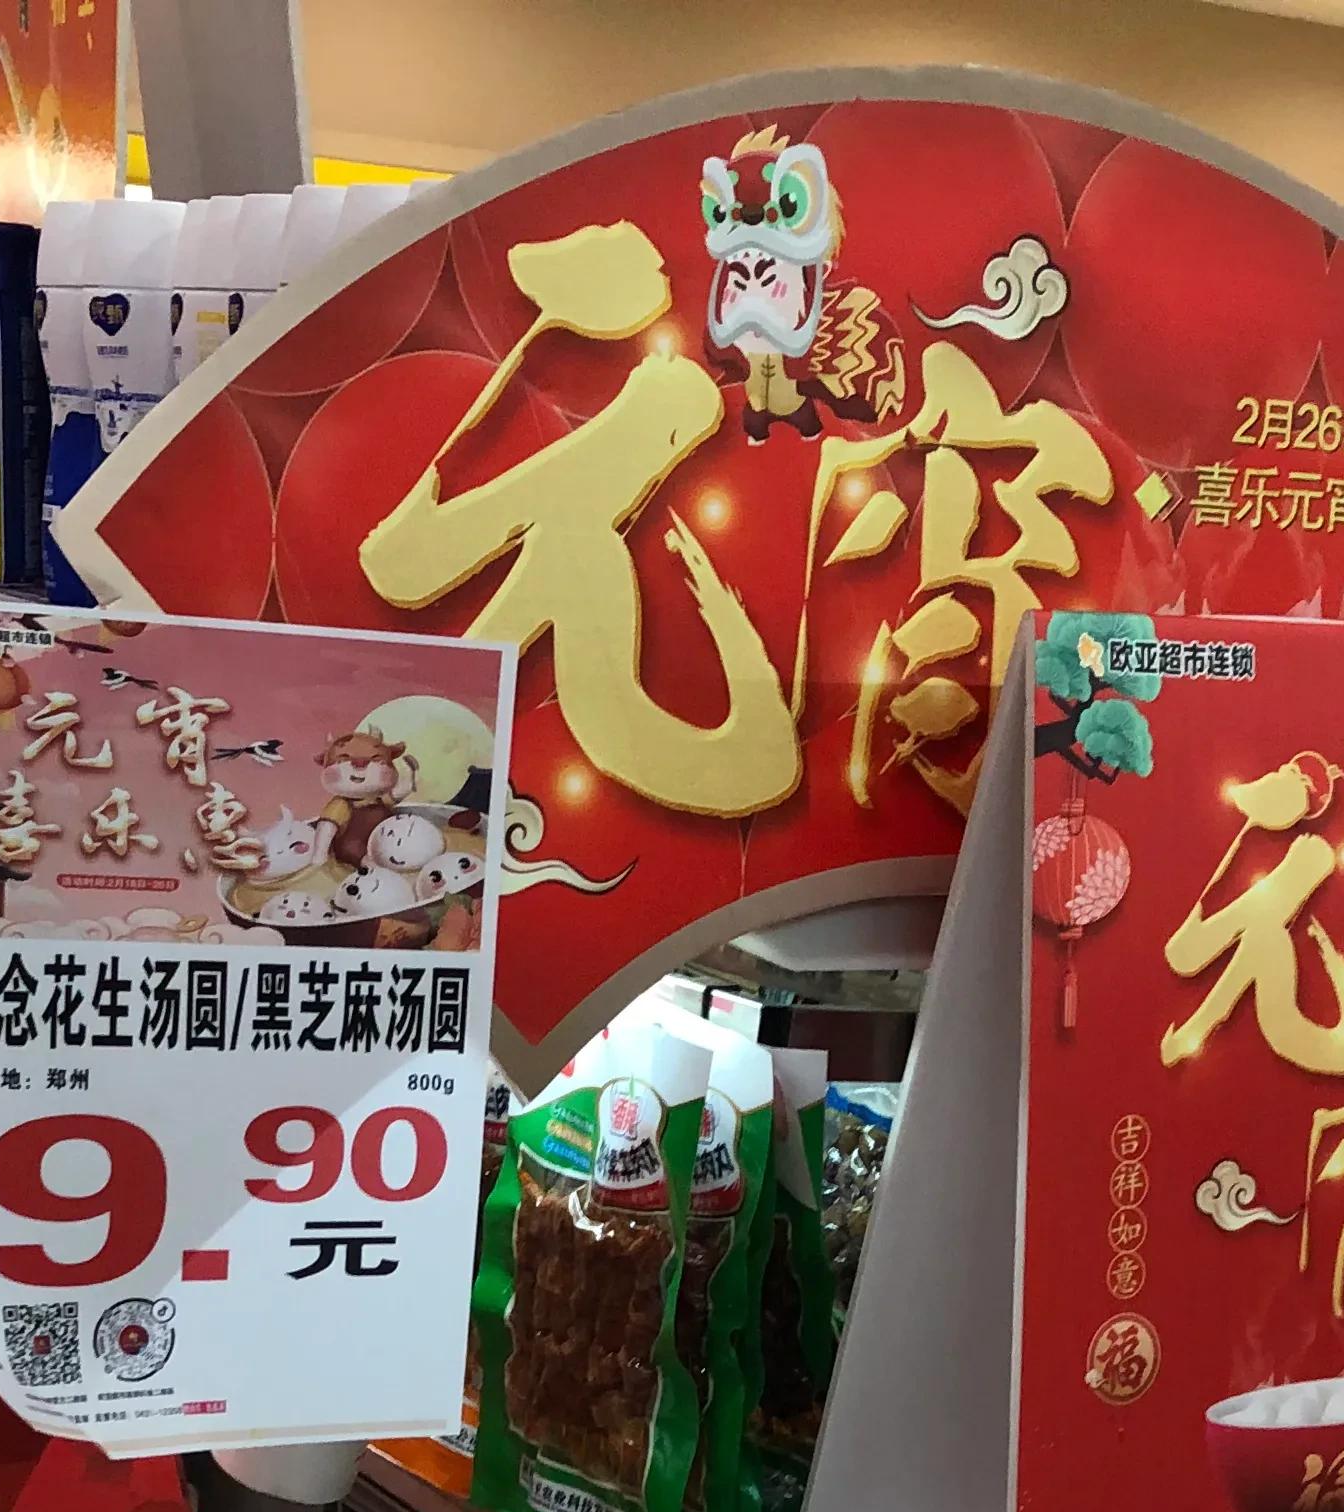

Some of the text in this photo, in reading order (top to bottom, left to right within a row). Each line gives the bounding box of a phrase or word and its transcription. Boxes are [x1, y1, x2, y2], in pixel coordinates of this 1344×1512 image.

[358, 218, 1114, 818] 元宵
[1108, 638, 1256, 681] 欧亚超市连锁
[21, 686, 231, 786] 元宵
[407, 1074, 456, 1096] 800g
[1109, 1116, 1149, 1296] 吉祥如意
[285, 1219, 401, 1281] 元
[1094, 1328, 1149, 1393] 福
